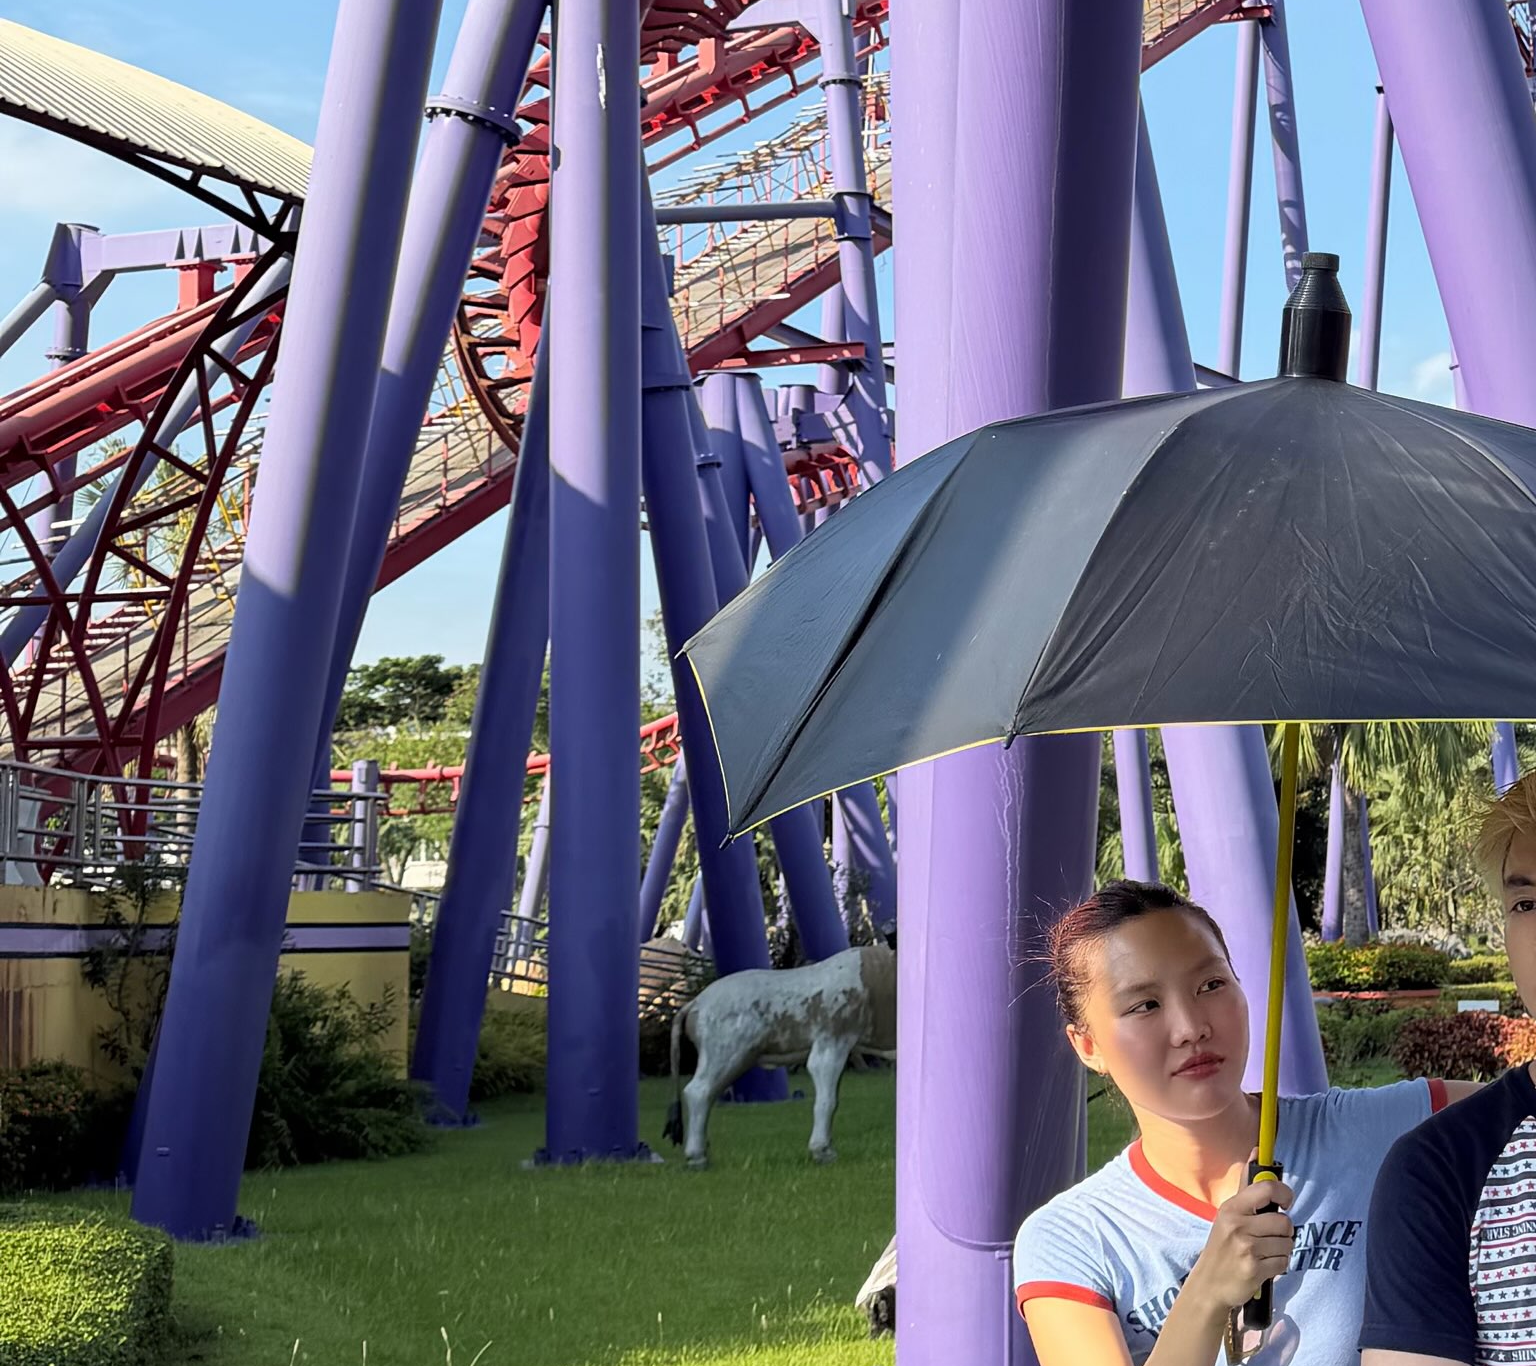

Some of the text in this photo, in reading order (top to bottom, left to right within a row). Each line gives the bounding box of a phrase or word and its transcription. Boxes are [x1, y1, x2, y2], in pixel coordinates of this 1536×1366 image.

[1293, 1219, 1363, 1248] ENCE
[1486, 1225, 1510, 1240] STAR
[1293, 1246, 1344, 1271] TER
[1126, 1286, 1180, 1334] SHO
